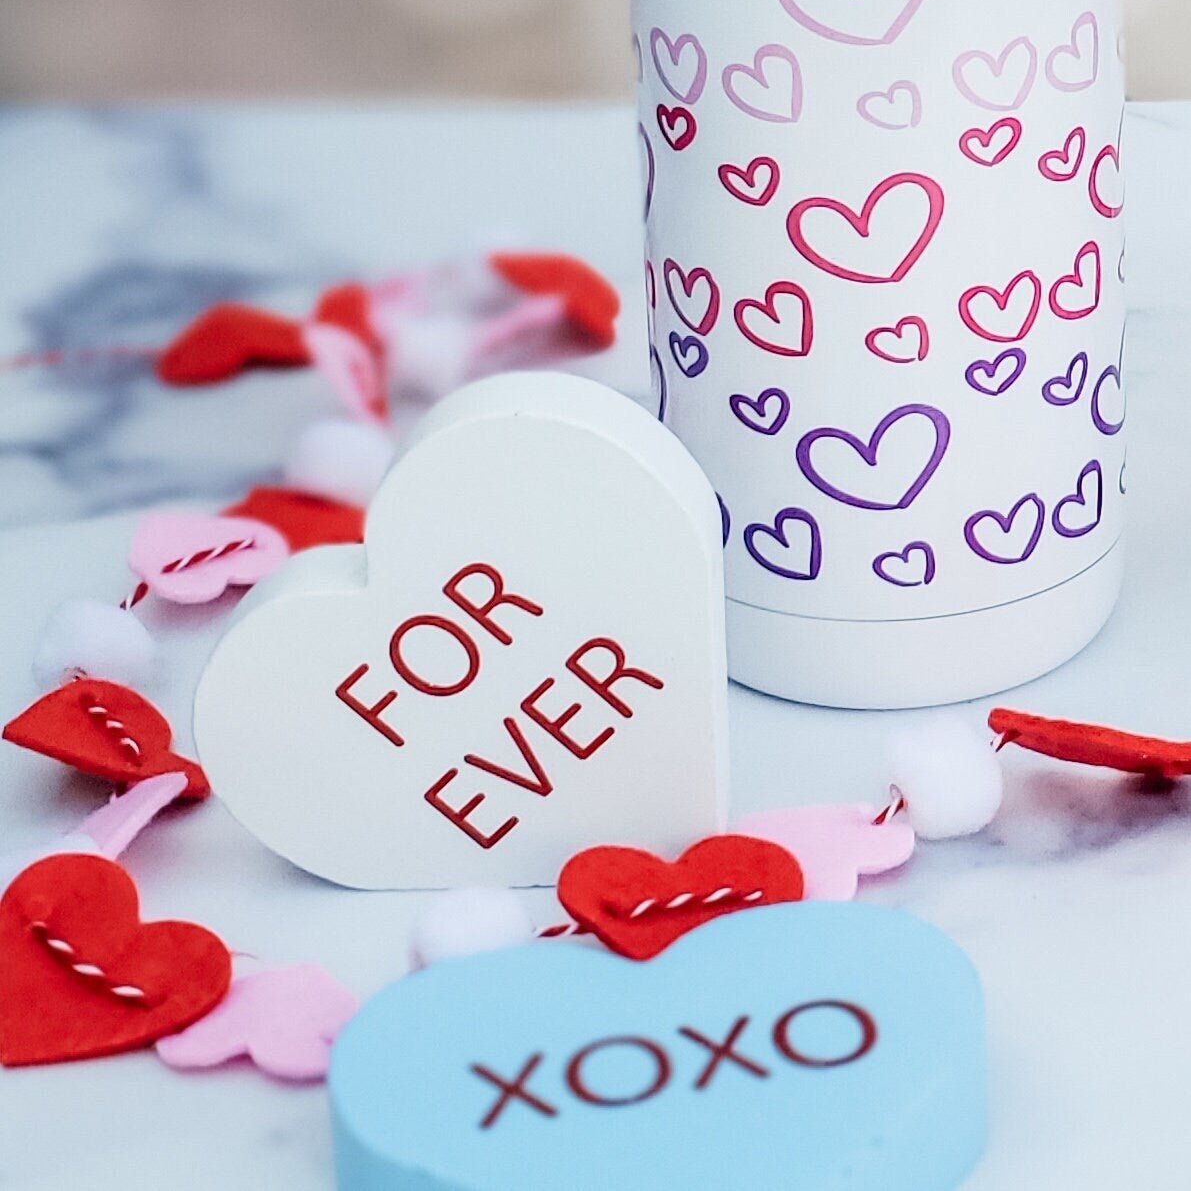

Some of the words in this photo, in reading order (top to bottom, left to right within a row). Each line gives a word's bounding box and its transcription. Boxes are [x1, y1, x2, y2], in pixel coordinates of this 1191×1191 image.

[335, 563, 543, 747] FOR
[424, 637, 664, 849] EVER
[470, 999, 878, 1130] XOXO
